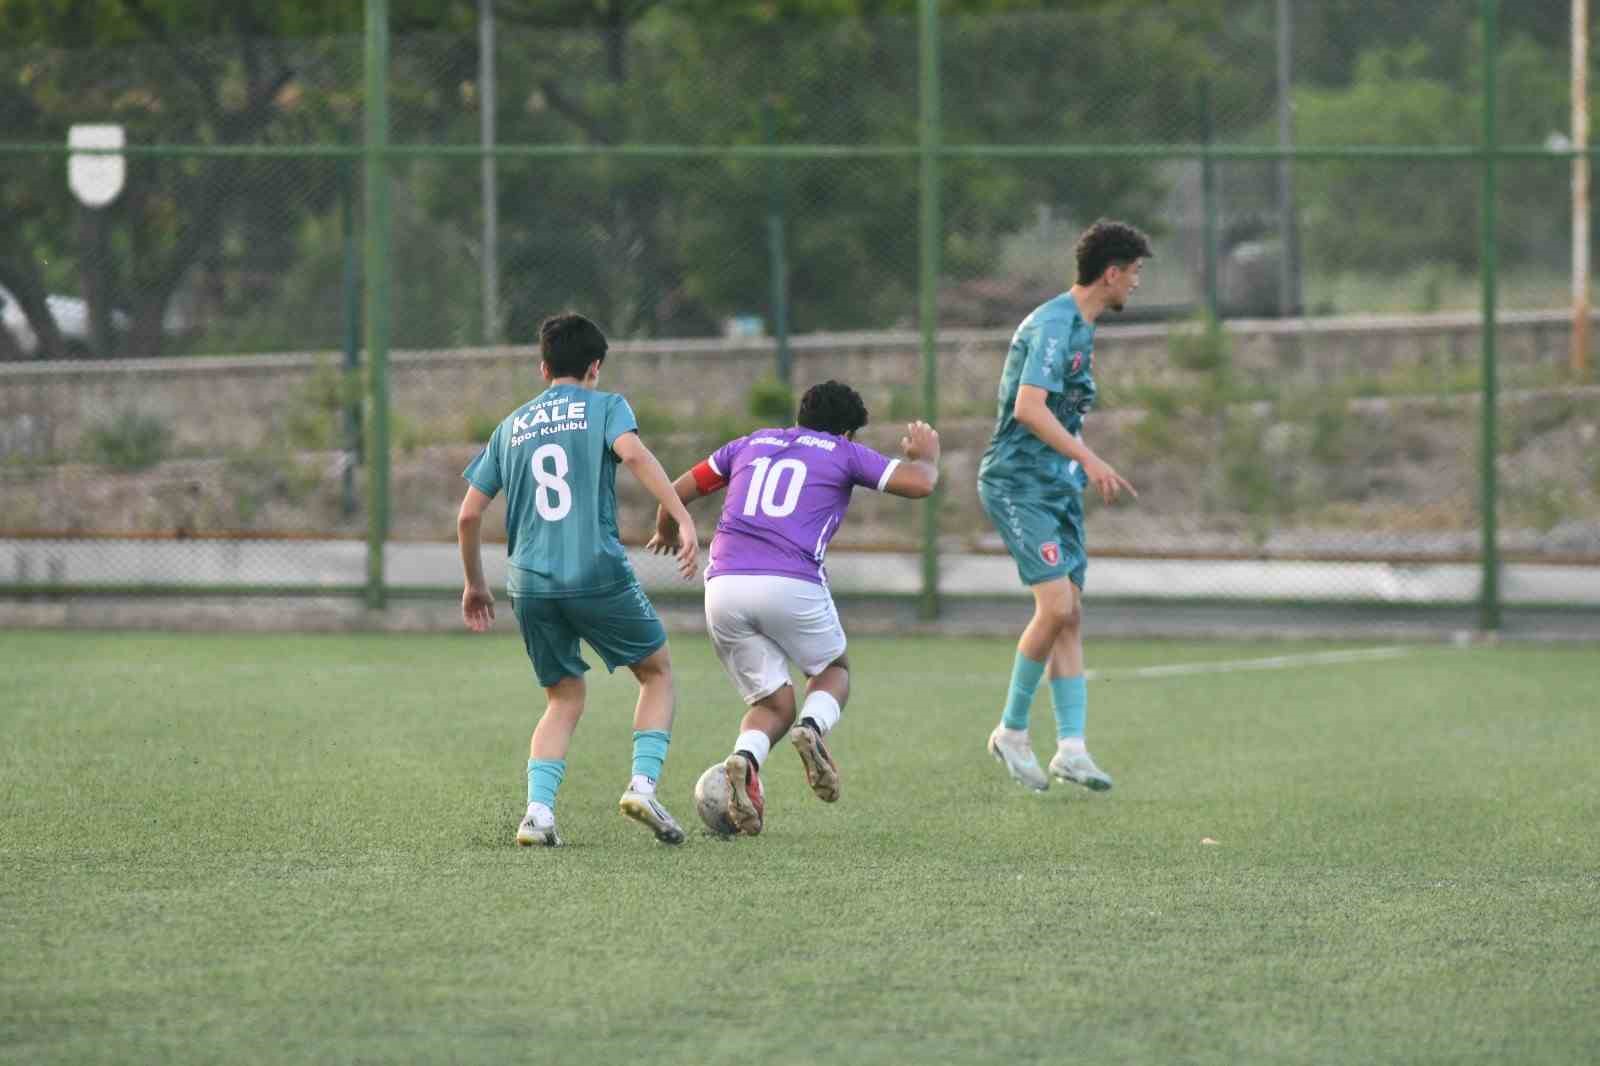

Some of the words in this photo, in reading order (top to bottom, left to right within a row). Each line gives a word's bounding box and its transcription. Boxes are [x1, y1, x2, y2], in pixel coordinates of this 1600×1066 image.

[511, 431, 538, 448] Spor
[512, 401, 586, 434] KALE
[531, 443, 572, 522] 8
[743, 456, 808, 518] 10
